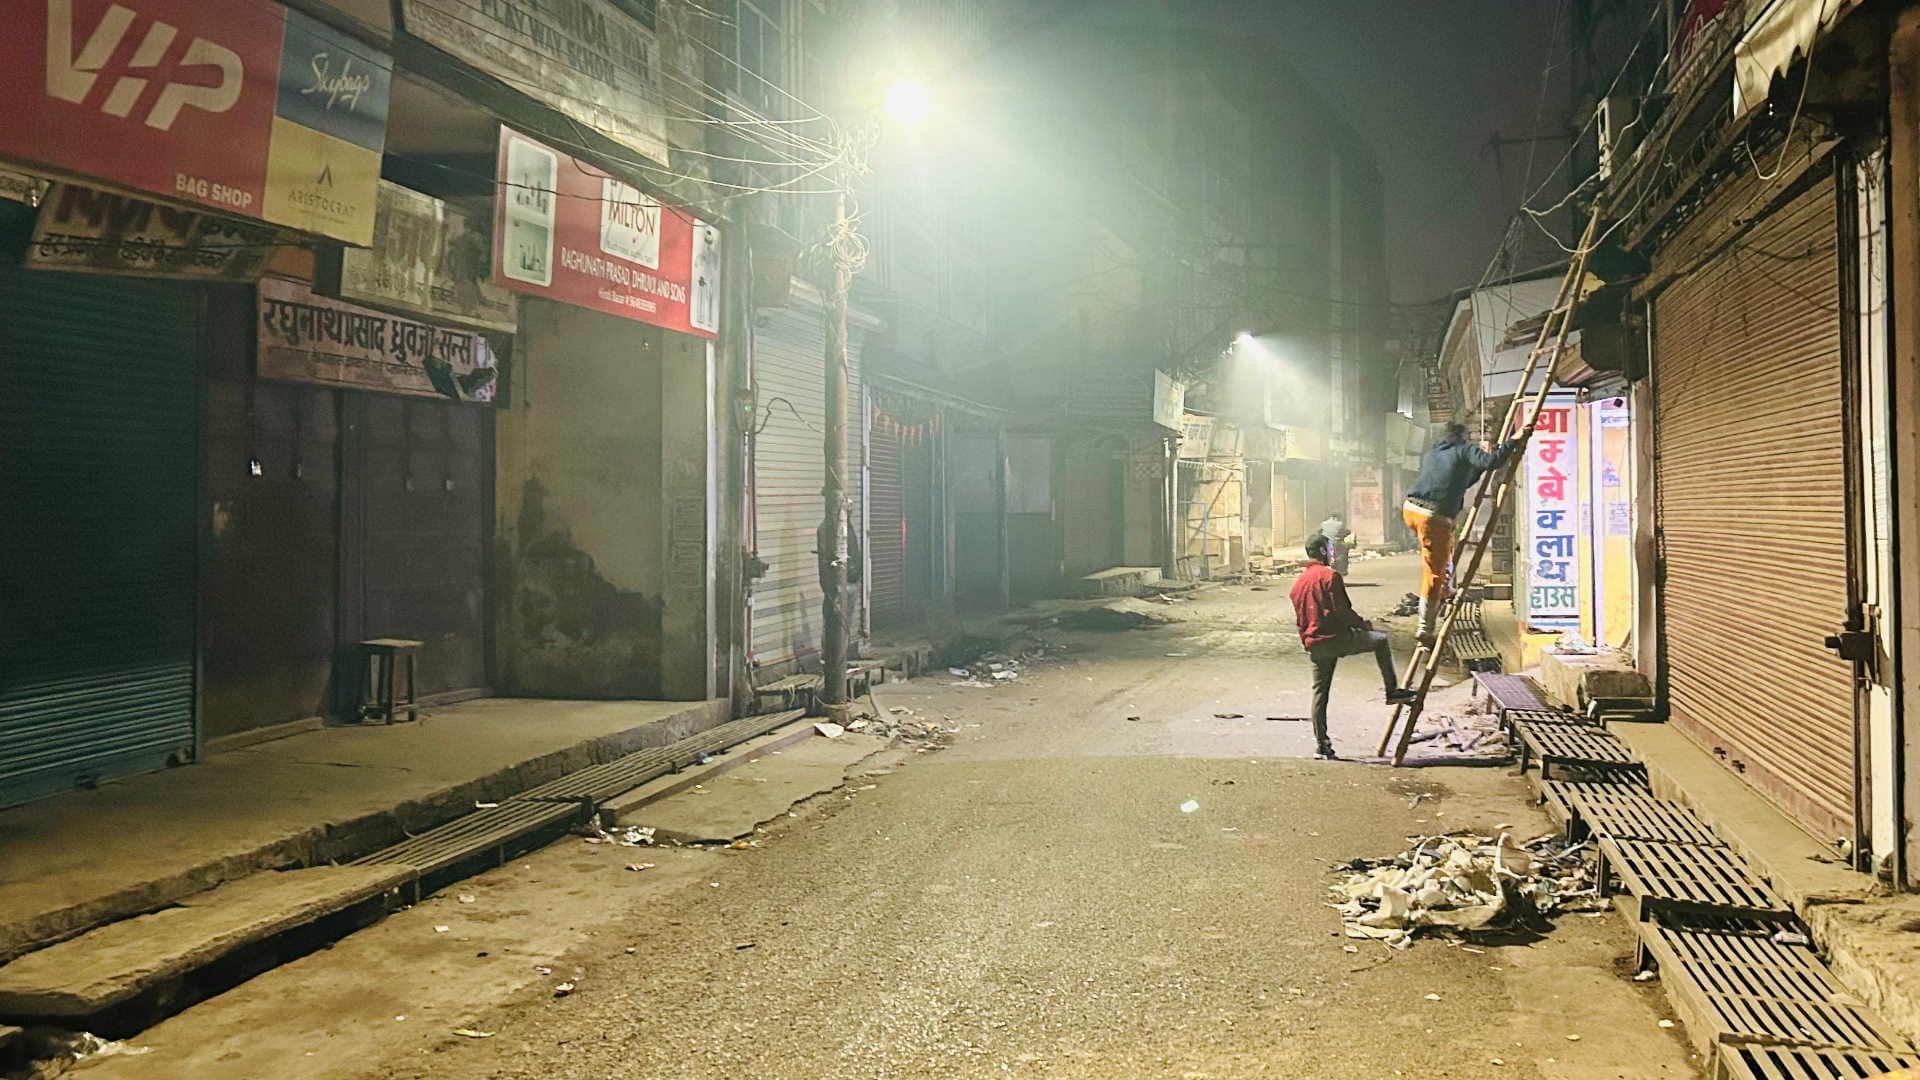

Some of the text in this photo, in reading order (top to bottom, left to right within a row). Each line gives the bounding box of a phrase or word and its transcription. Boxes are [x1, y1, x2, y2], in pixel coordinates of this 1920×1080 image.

[46, 0, 244, 131] VIP
[301, 53, 370, 111] Skybags
[175, 173, 253, 209] BAG SHOP
[287, 190, 357, 217] ARISTOCRAT
[608, 201, 655, 237] MILTON
[560, 247, 606, 279] RAGHUNATH
[657, 280, 670, 299] AND
[670, 282, 686, 304] SONS
[1530, 585, 1577, 609] हाउस
